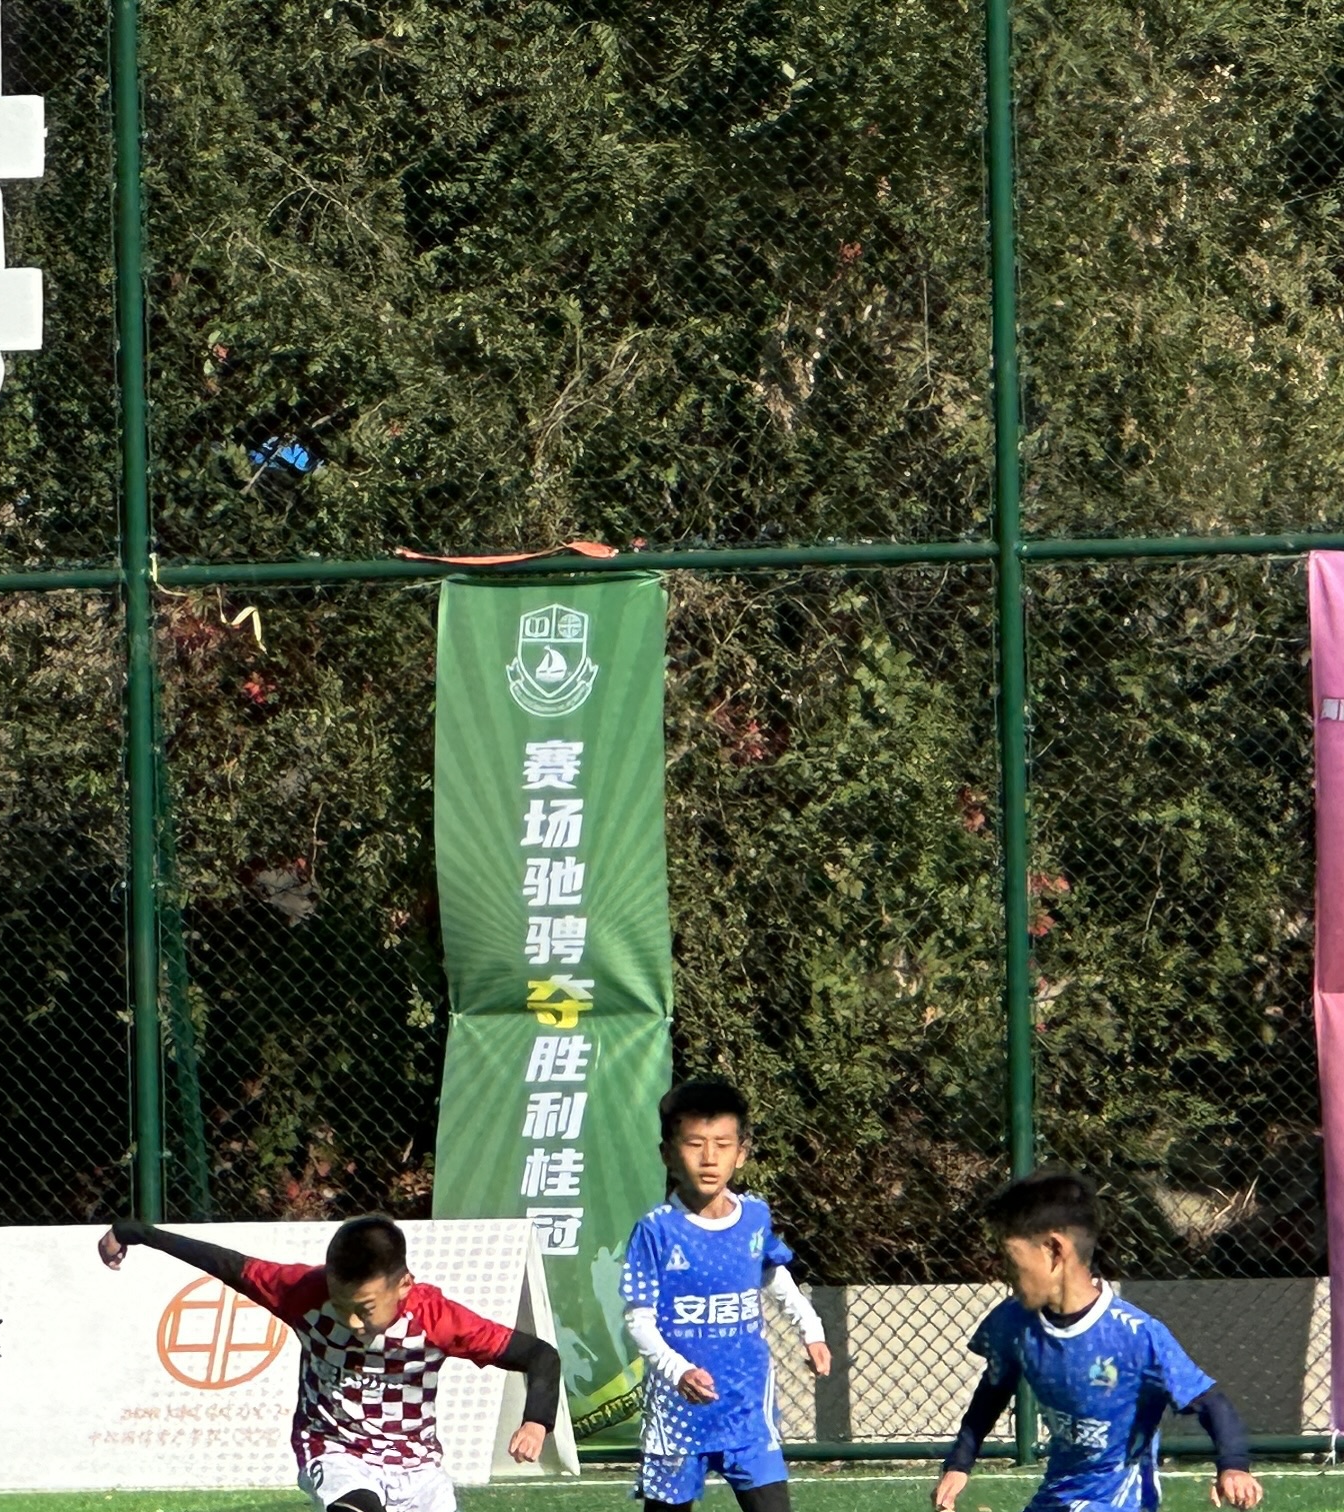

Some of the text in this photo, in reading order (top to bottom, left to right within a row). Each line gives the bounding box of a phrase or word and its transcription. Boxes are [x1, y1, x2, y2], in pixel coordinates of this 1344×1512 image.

[519, 739, 596, 1256] 赛场驰骋夺胜利桂冠
